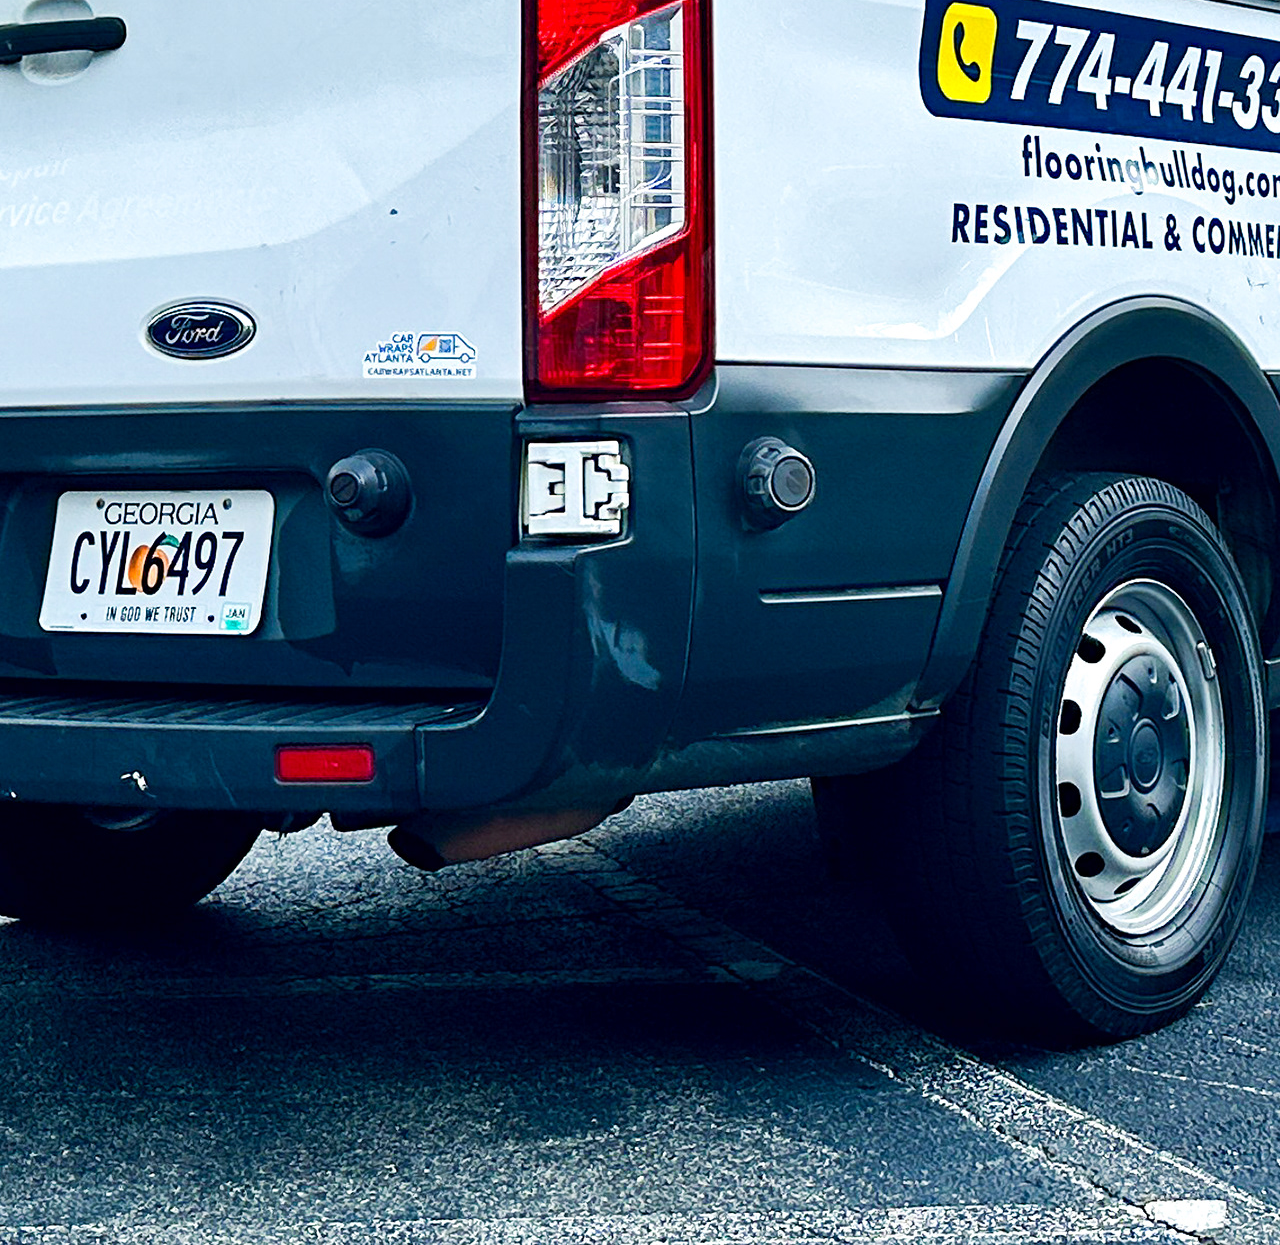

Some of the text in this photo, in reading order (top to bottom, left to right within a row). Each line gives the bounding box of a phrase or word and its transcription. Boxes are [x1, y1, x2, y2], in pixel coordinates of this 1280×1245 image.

[951, 202, 1153, 249] RESIDENTIAL
[1164, 214, 1183, 251] &
[165, 313, 224, 345] Ford
[392, 334, 413, 343] CAR
[378, 343, 413, 353] WRAPS
[364, 353, 414, 363] ATLANTA
[104, 502, 219, 525] GEORGIA
[70, 530, 245, 596] CYL6497
[106, 606, 197, 622] IN GOD WE TRUST
[225, 608, 246, 618] JAN
